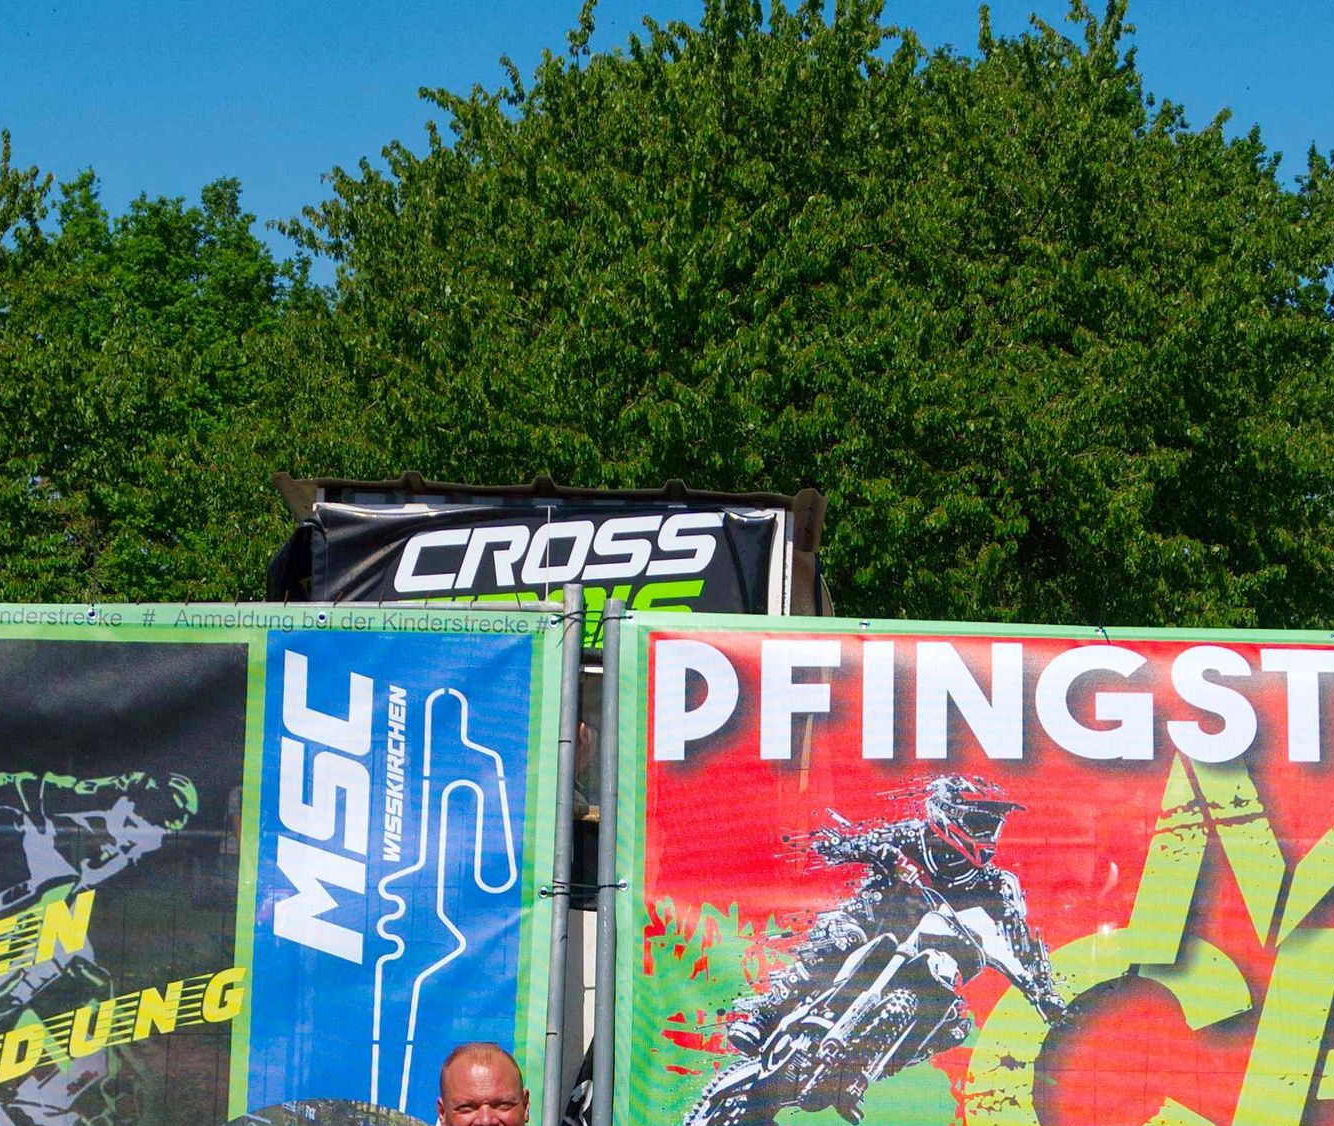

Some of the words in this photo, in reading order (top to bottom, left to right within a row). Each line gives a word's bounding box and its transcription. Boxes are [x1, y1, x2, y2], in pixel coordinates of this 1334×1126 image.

[393, 511, 729, 594] CROSS
[141, 608, 155, 626] #
[173, 608, 295, 633] Anmeldung
[341, 611, 375, 632] der
[383, 611, 529, 634] Kinderstrecke
[273, 650, 374, 966] MSC
[381, 685, 409, 864] WISSKIRCHEN
